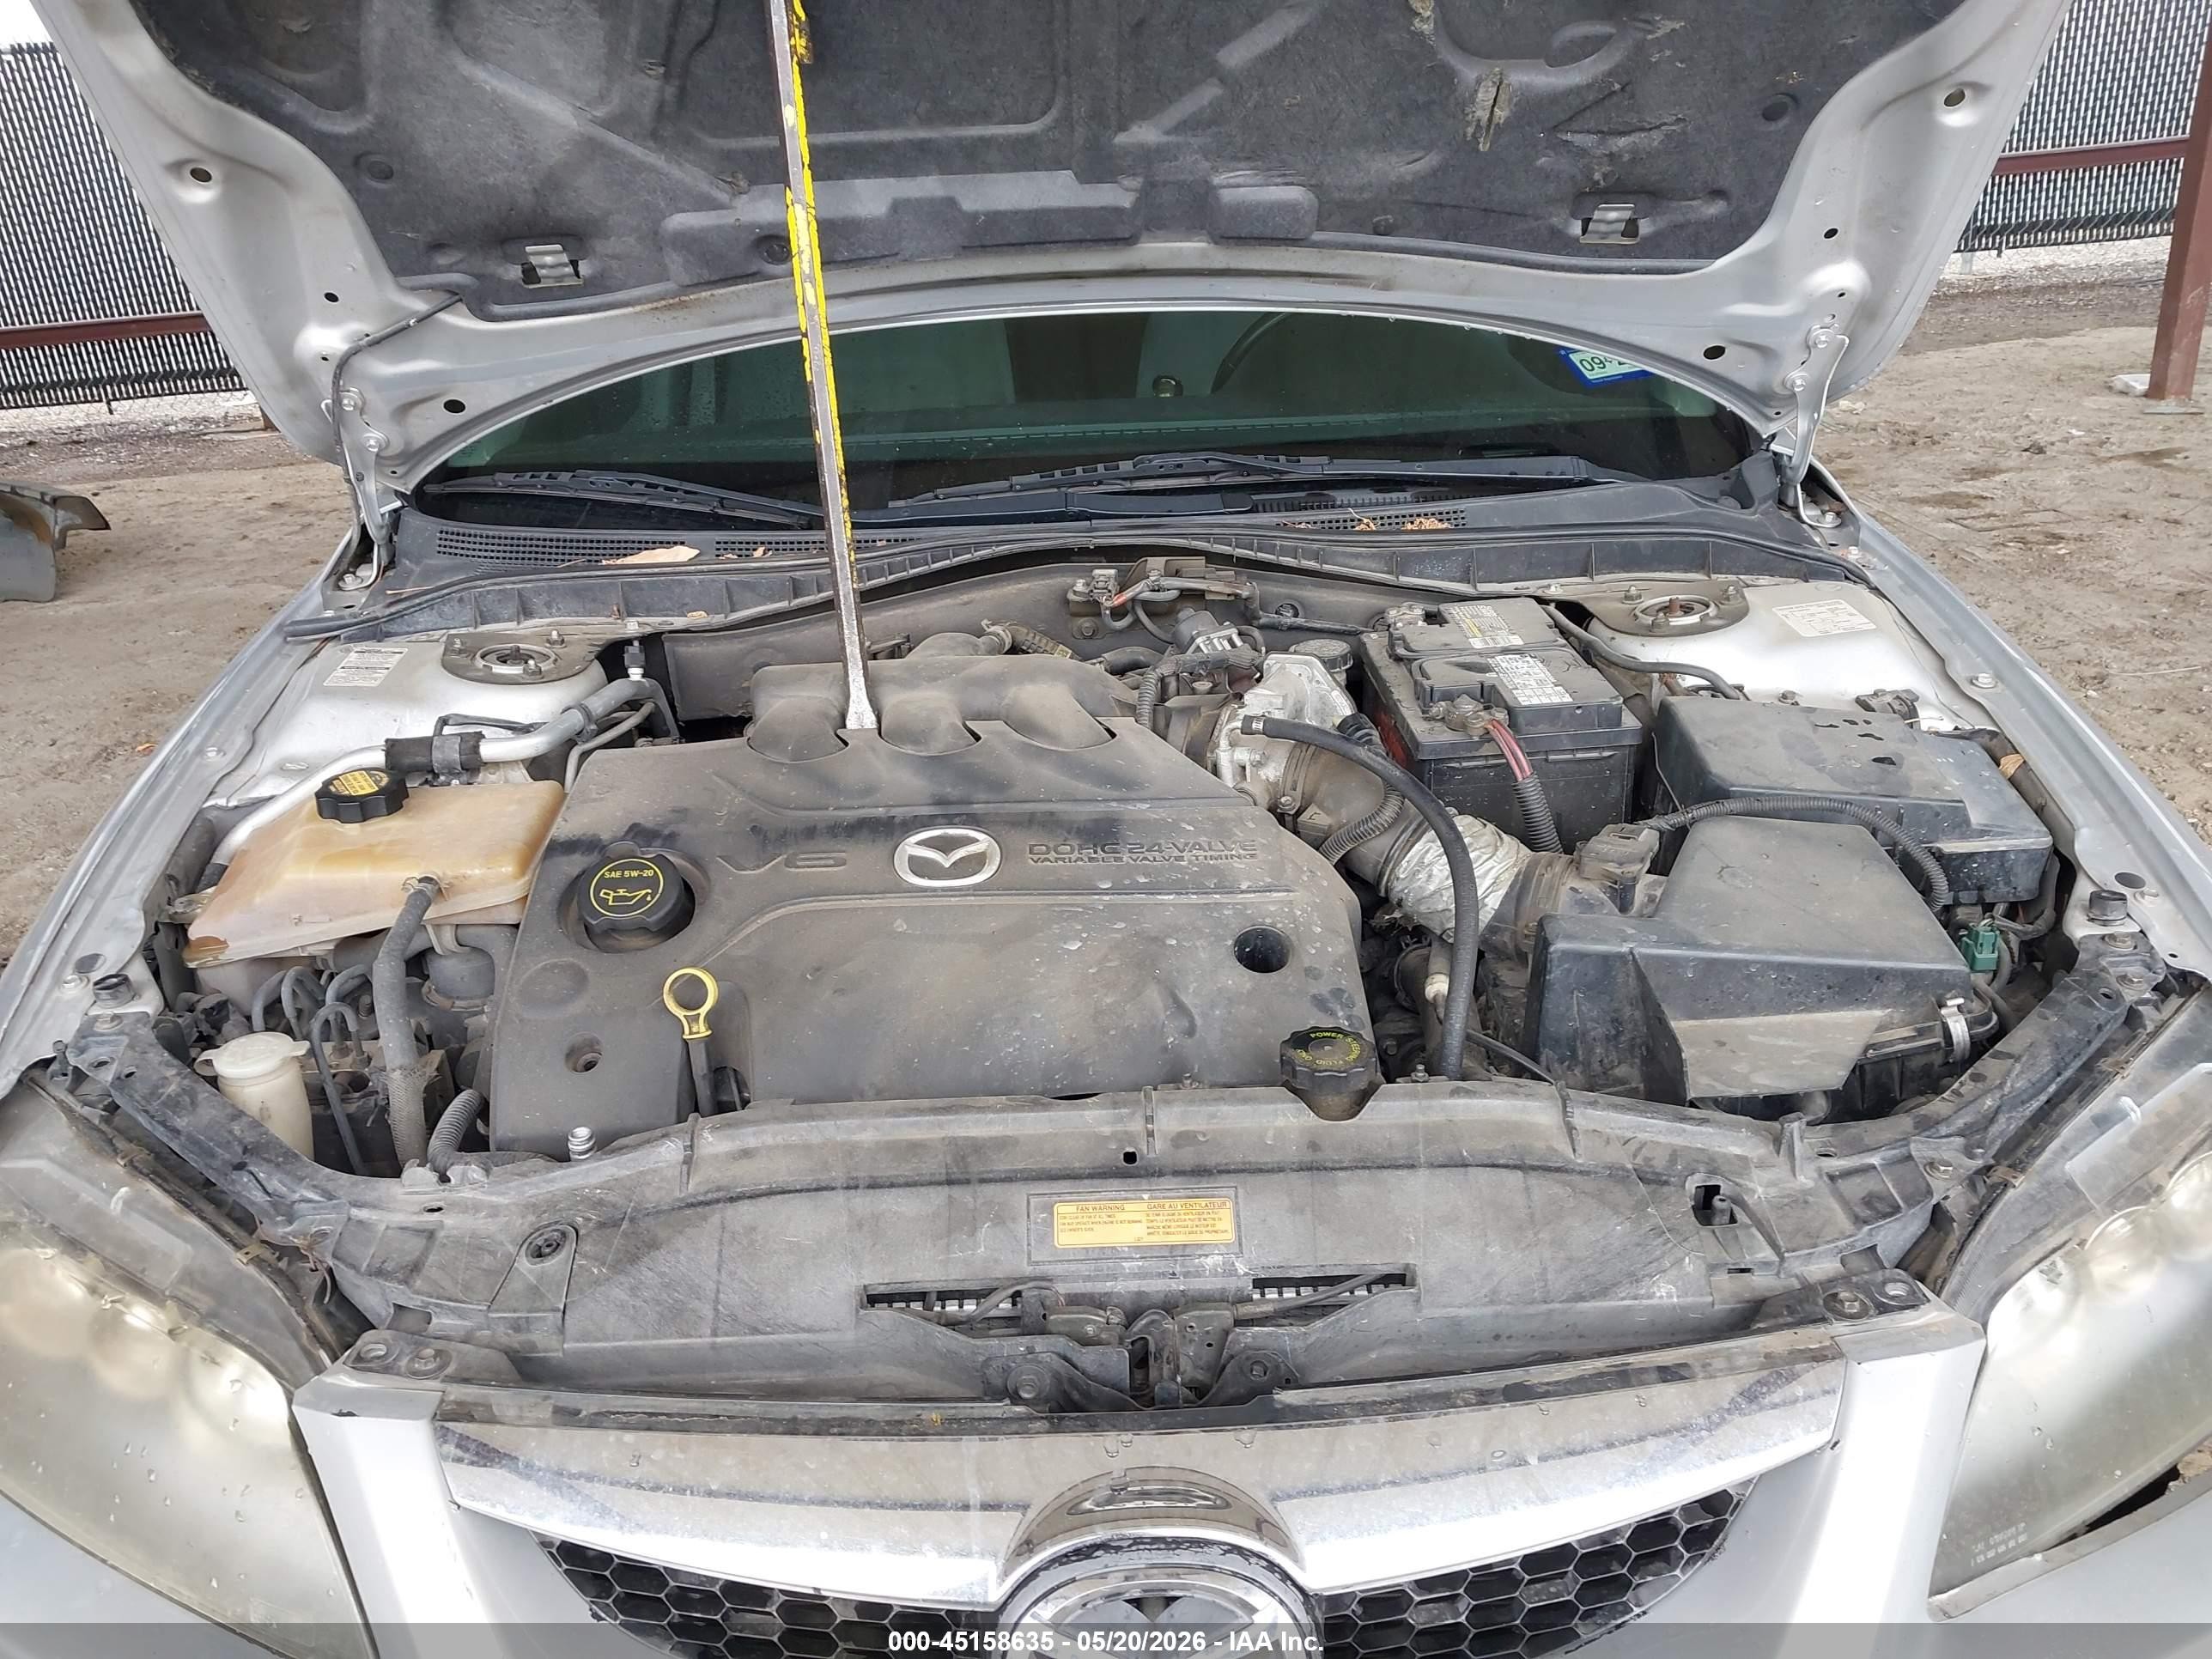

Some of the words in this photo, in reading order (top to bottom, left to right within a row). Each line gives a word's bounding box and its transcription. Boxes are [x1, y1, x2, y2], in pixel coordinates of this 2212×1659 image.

[1029, 842, 1120, 855] DOHC
[1127, 840, 1257, 854] 24-VALVE
[716, 852, 847, 873] V6
[1126, 855, 1185, 864] VALVE
[1193, 853, 1257, 862] TIMING
[623, 869, 653, 878] 5W-20
